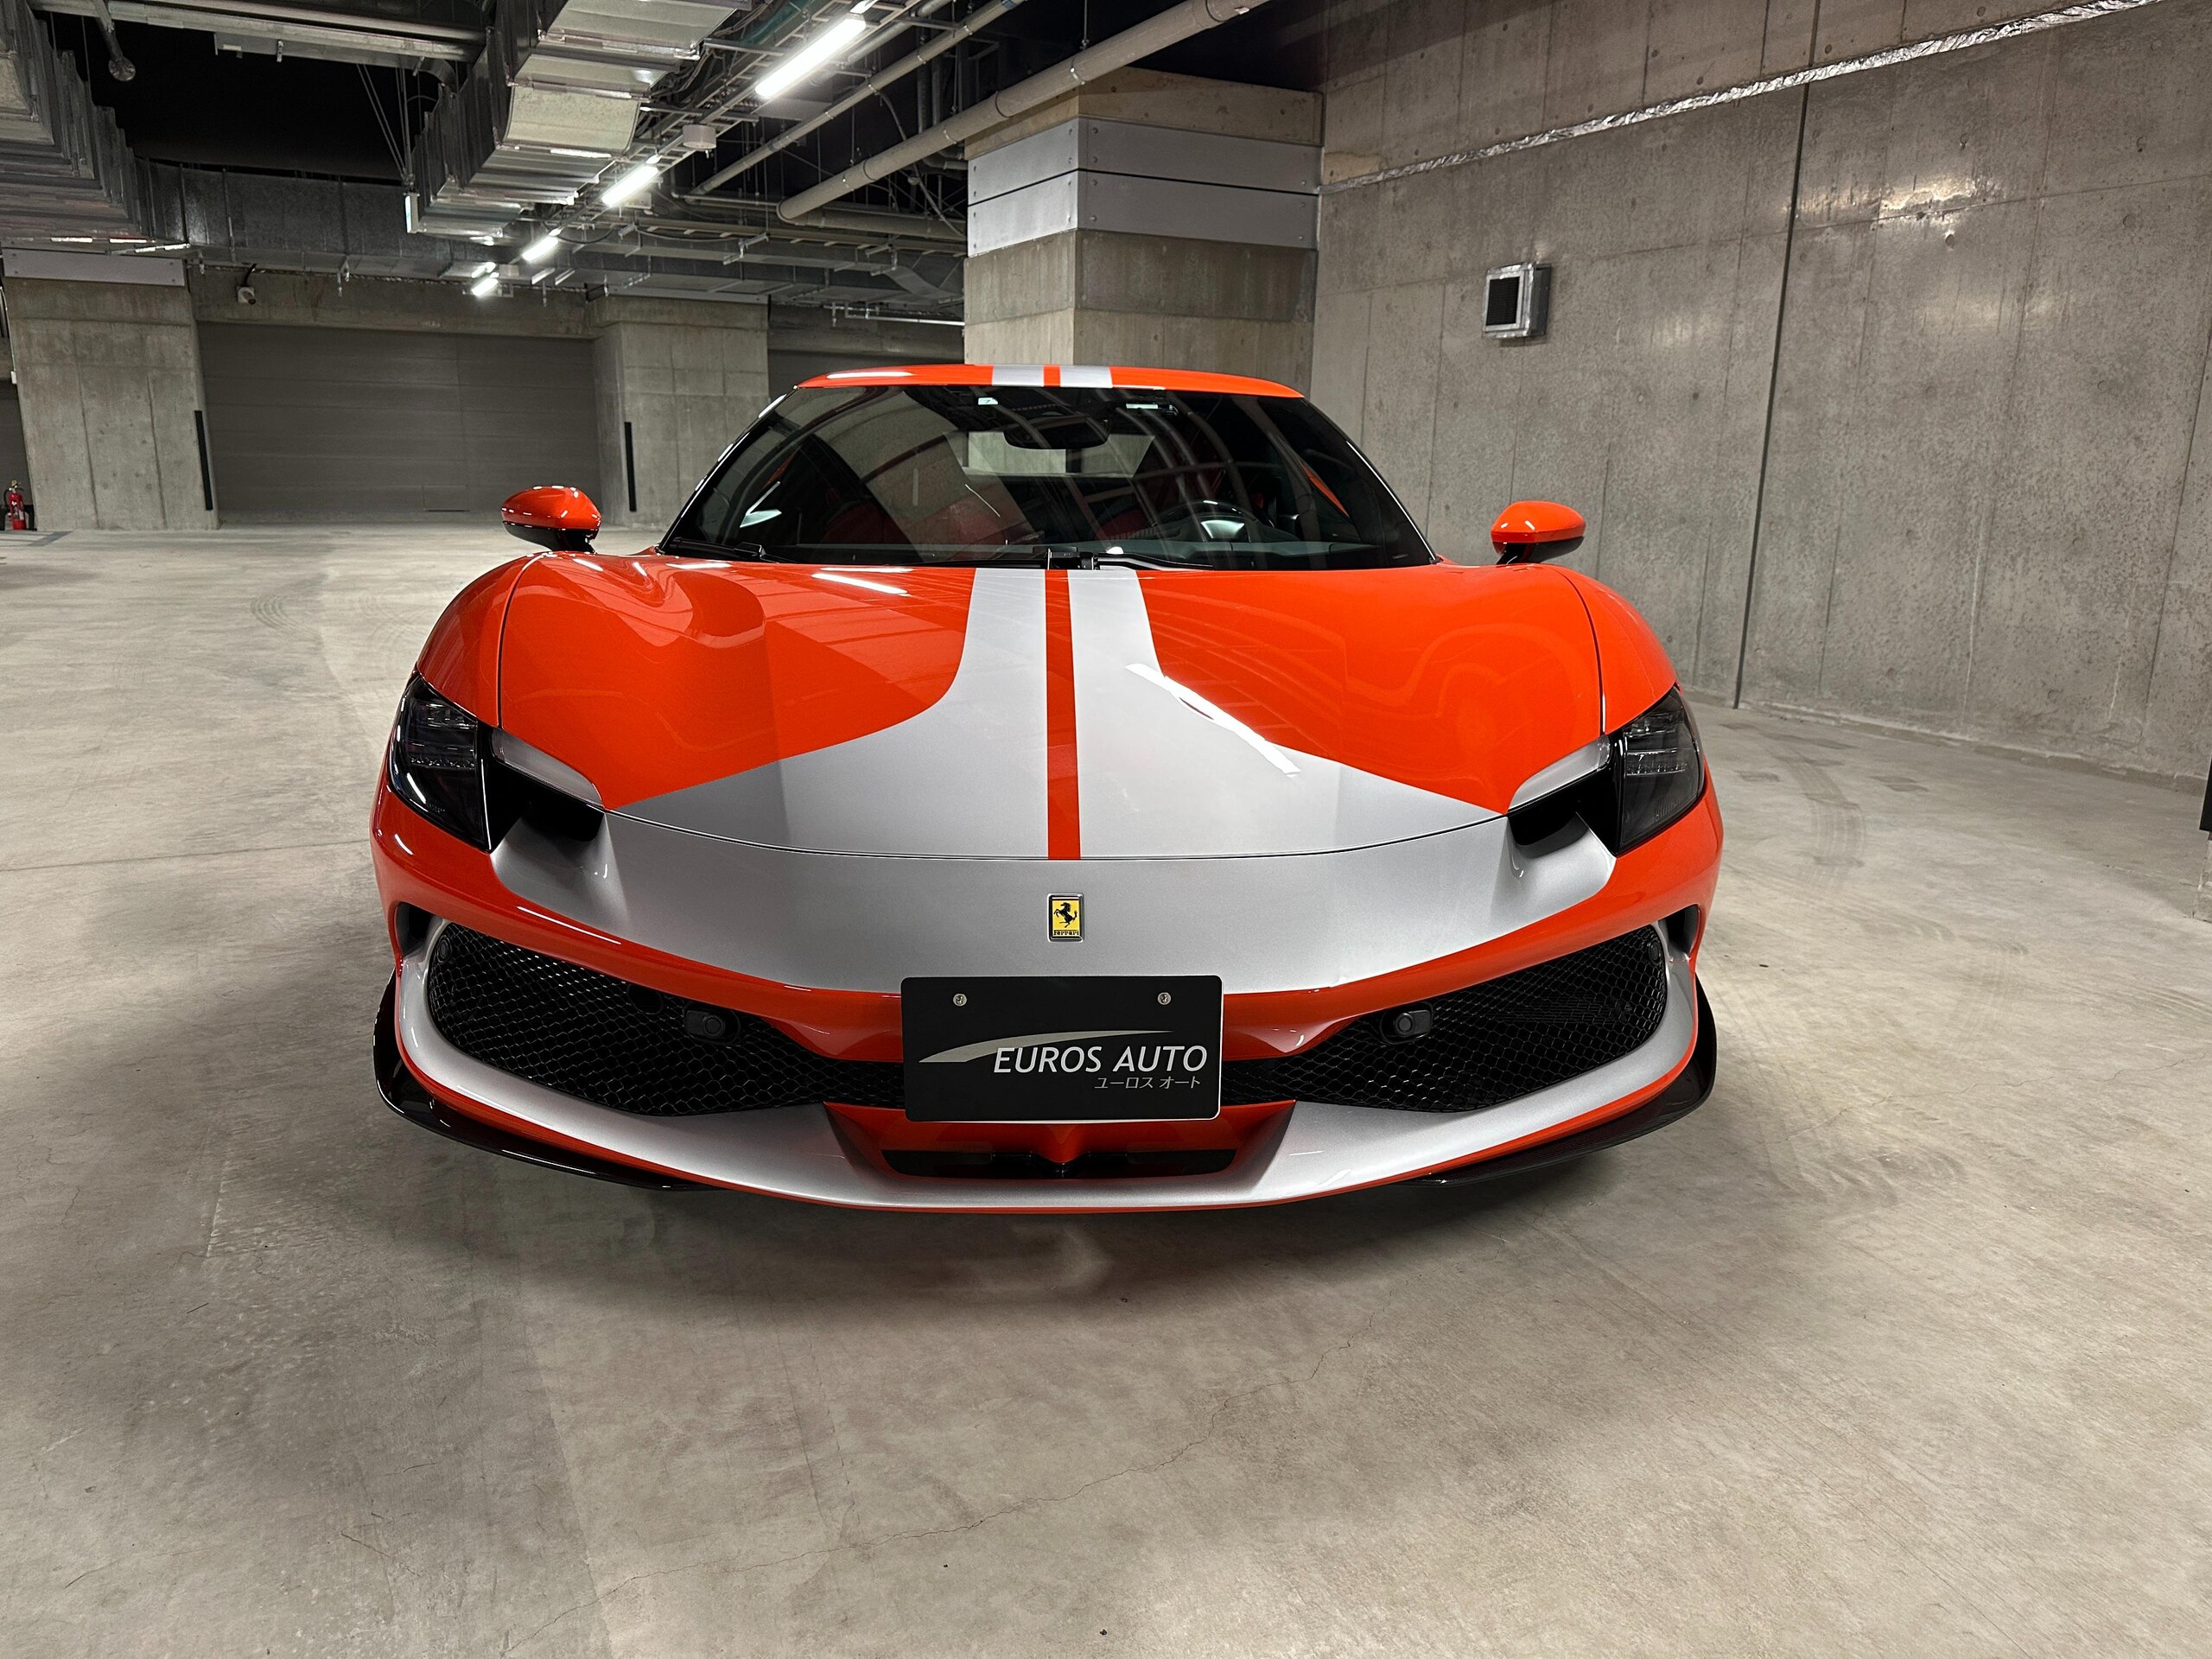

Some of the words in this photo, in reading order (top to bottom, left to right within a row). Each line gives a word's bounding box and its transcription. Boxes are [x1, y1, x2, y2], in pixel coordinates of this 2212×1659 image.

[994, 1046, 1103, 1073] EUROS
[1112, 1046, 1207, 1072] AUTO
[1094, 1077, 1154, 1090] ユーロス
[1159, 1075, 1201, 1090] オート
